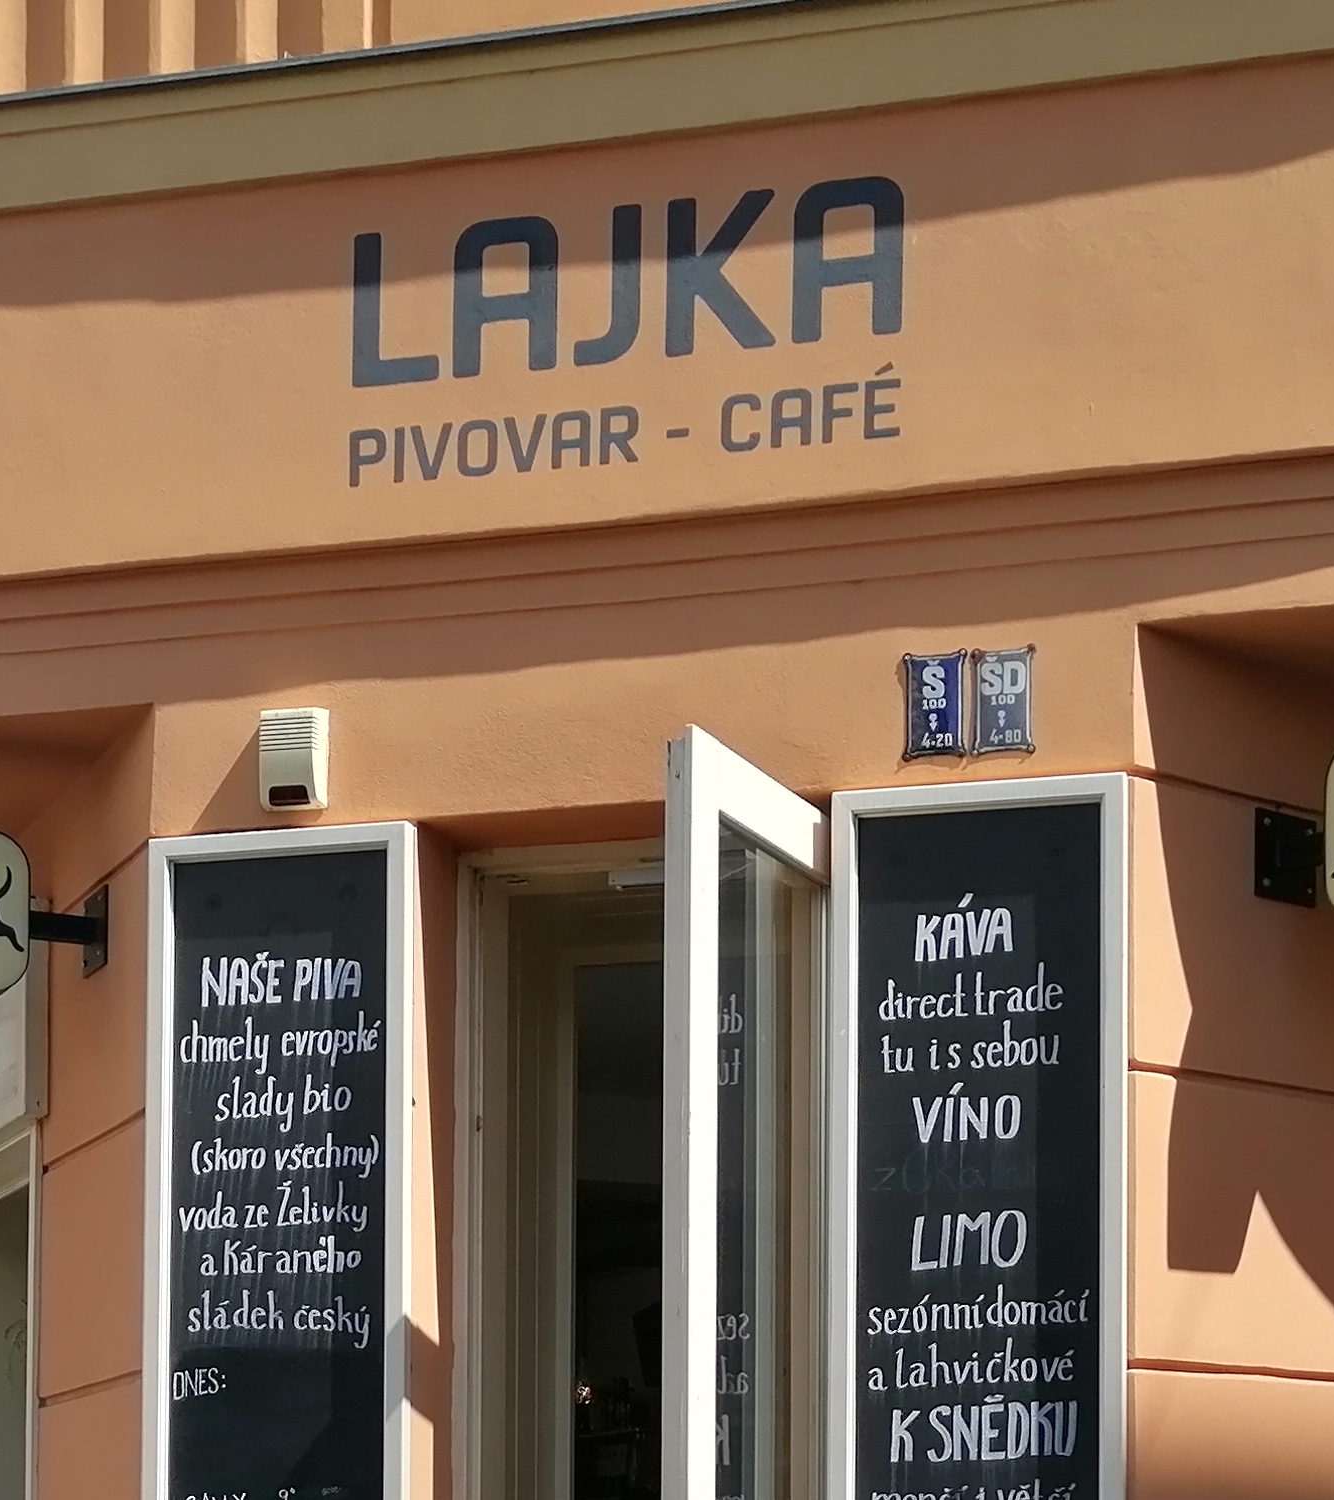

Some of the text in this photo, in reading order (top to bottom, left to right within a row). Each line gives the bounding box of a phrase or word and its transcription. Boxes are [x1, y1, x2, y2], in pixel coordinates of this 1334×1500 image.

[352, 175, 905, 388] LAJKA
[349, 405, 640, 488] PIVOVAR
[721, 361, 902, 453] CAFÉ
[922, 660, 946, 699] Š
[981, 656, 1026, 696] ŠD
[991, 694, 1016, 706] 100
[922, 698, 947, 710] 100
[915, 893, 1014, 962] KÁVA
[201, 952, 362, 1007] NAŠE PIVA
[878, 961, 1064, 1021] direct trade
[180, 1010, 382, 1075] chmely evropské
[881, 1034, 915, 1074] tu
[929, 1038, 940, 1071] i
[970, 1019, 1060, 1070] sebou
[214, 1074, 352, 1133] slady bio
[912, 1082, 1023, 1143] VÍNO
[191, 1133, 381, 1179] (skoro všechny)
[178, 1179, 368, 1233] voda ze Želivky
[200, 1235, 363, 1276] a Káraného
[910, 1209, 1028, 1271] LIMO
[187, 1289, 372, 1350] sládek český
[867, 1283, 1090, 1335] sezónní domácí
[172, 1367, 228, 1401] DNES:
[868, 1337, 1075, 1391] a lahvičkové
[890, 1394, 1078, 1463] K SNĚDKU
